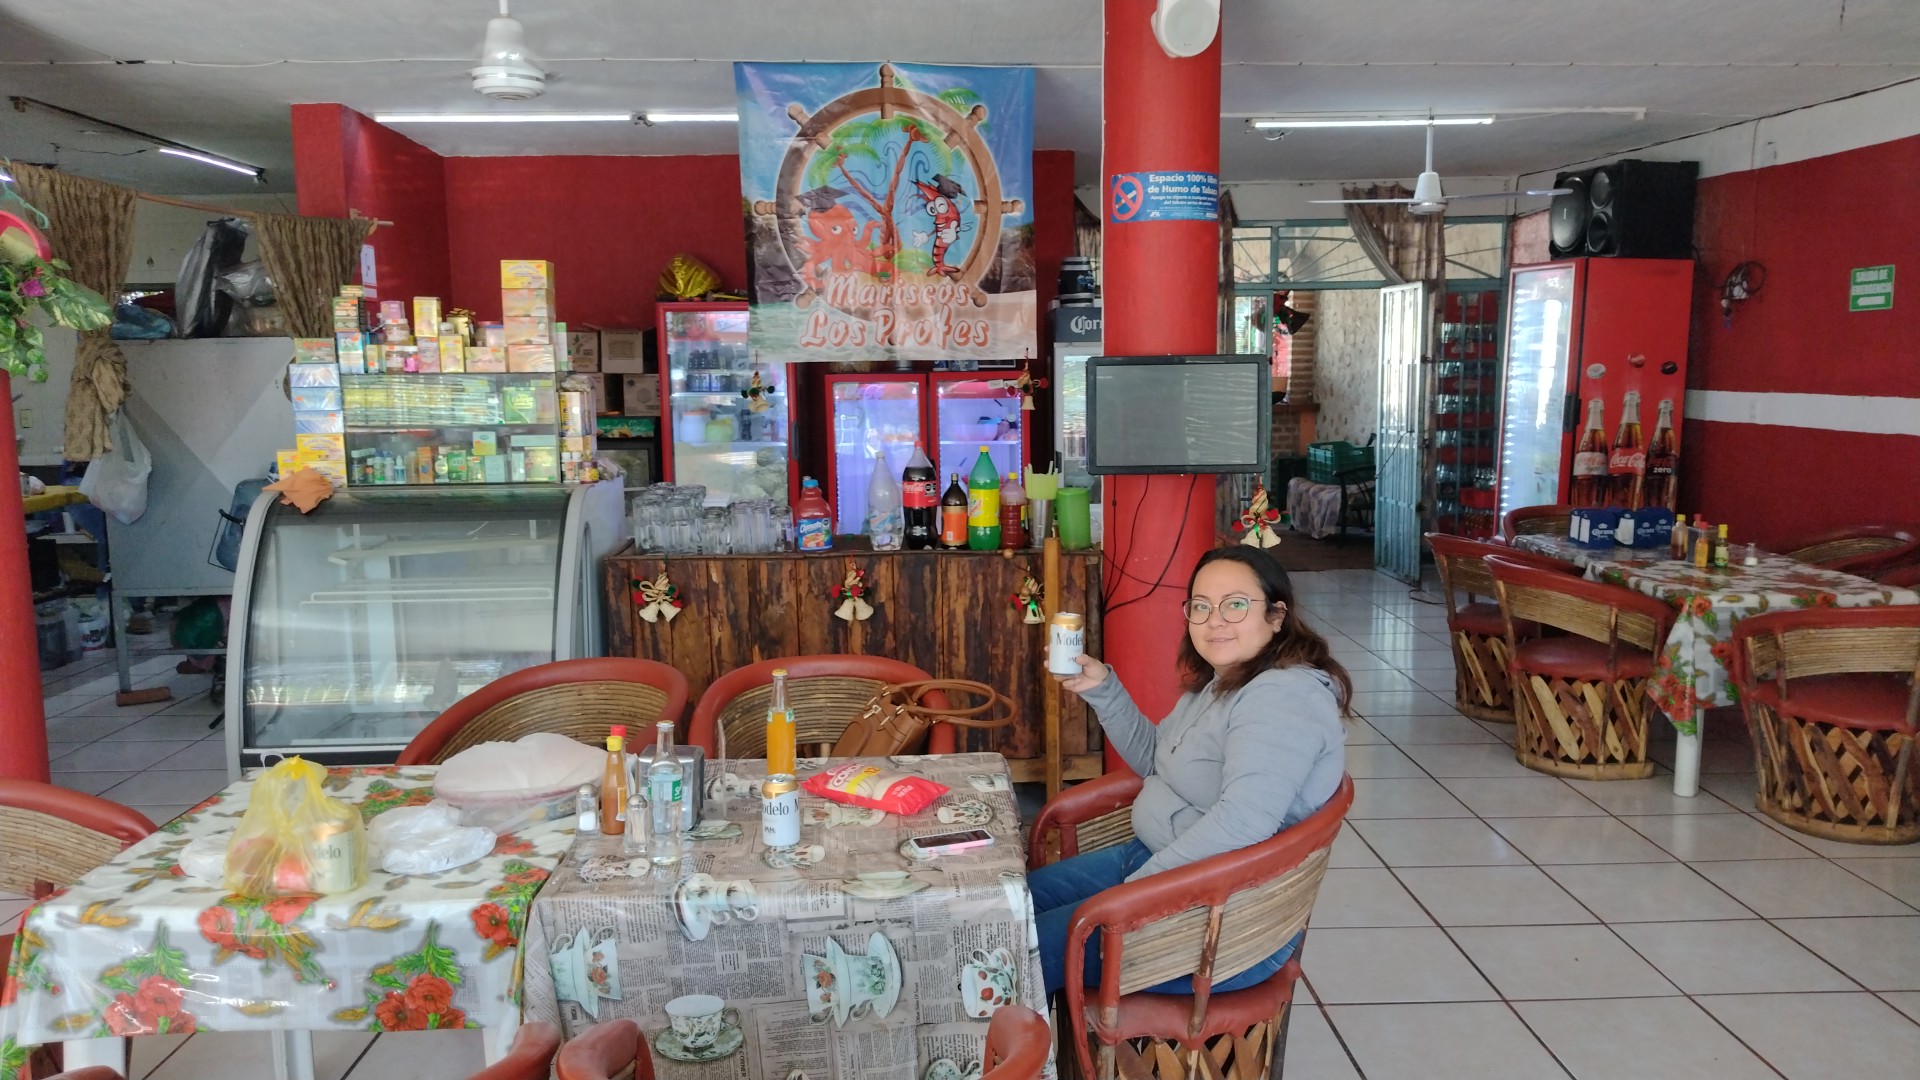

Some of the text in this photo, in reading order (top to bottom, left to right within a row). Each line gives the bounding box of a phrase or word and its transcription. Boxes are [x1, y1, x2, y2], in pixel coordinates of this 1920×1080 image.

[1149, 174, 1184, 183] Espacio
[1187, 174, 1206, 183] 100%
[1148, 185, 1160, 193] de
[1162, 185, 1189, 193] Humo
[1190, 185, 1200, 193] de
[827, 274, 971, 308] Mariscos
[801, 303, 989, 350] Los Profes
[1070, 315, 1102, 335] Cor
[1591, 528, 1614, 536] Corona
